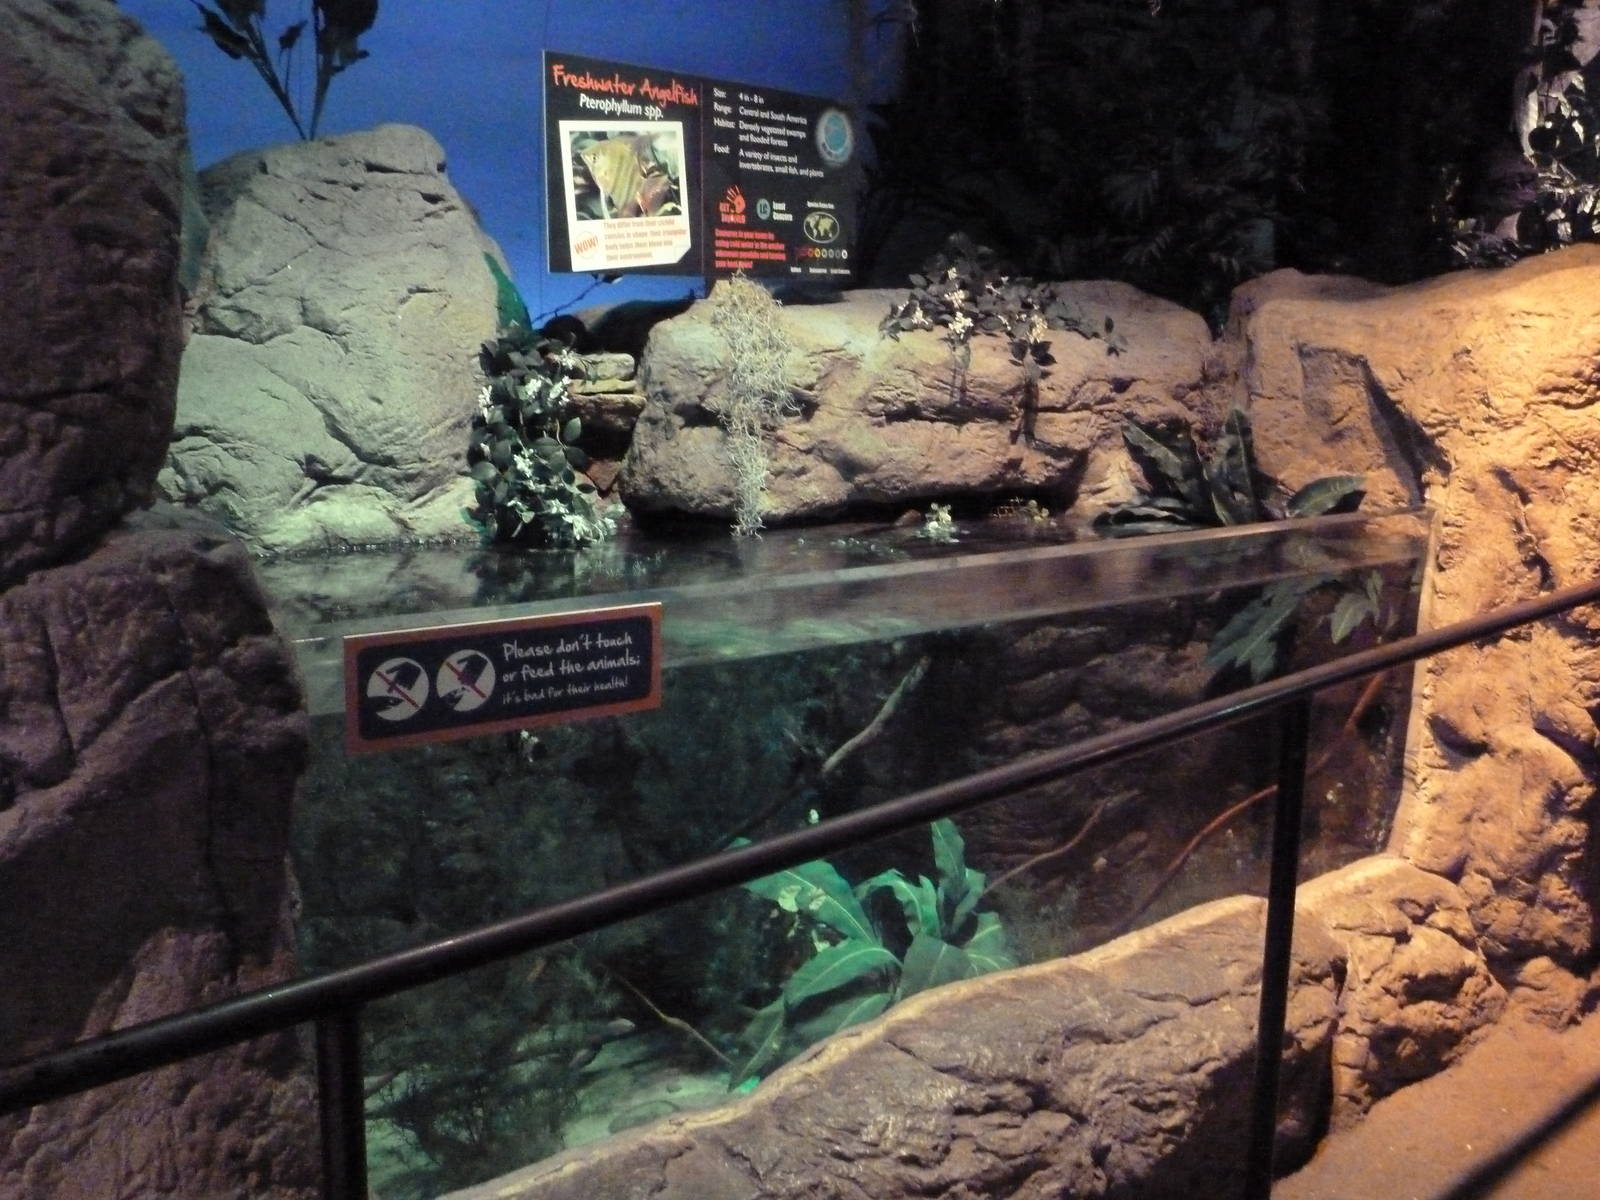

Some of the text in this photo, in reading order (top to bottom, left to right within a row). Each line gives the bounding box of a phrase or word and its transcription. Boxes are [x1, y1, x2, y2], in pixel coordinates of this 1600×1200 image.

[552, 64, 698, 108] Freshwater Angelfish
[713, 87, 726, 98] Size:
[579, 93, 664, 120] Pterophyllum spp.
[713, 102, 732, 115] Range:
[713, 117, 736, 129] Habitat:
[739, 106, 808, 125] Central and South America
[739, 120, 760, 133] Densely
[761, 125, 786, 136] vegetated
[739, 133, 788, 147] and flooded forests
[713, 143, 730, 154] Food:
[739, 148, 745, 157] A
[745, 149, 763, 161] variety
[763, 152, 770, 160] of
[787, 155, 798, 164] and
[799, 168, 809, 176] and
[574, 235, 599, 255] WOW!
[502, 631, 633, 661] Please don't touch
[502, 671, 517, 683] or
[521, 662, 555, 681] feed
[559, 659, 585, 675] the
[523, 688, 545, 702] bad
[548, 686, 564, 700] for
[566, 682, 591, 696] their
